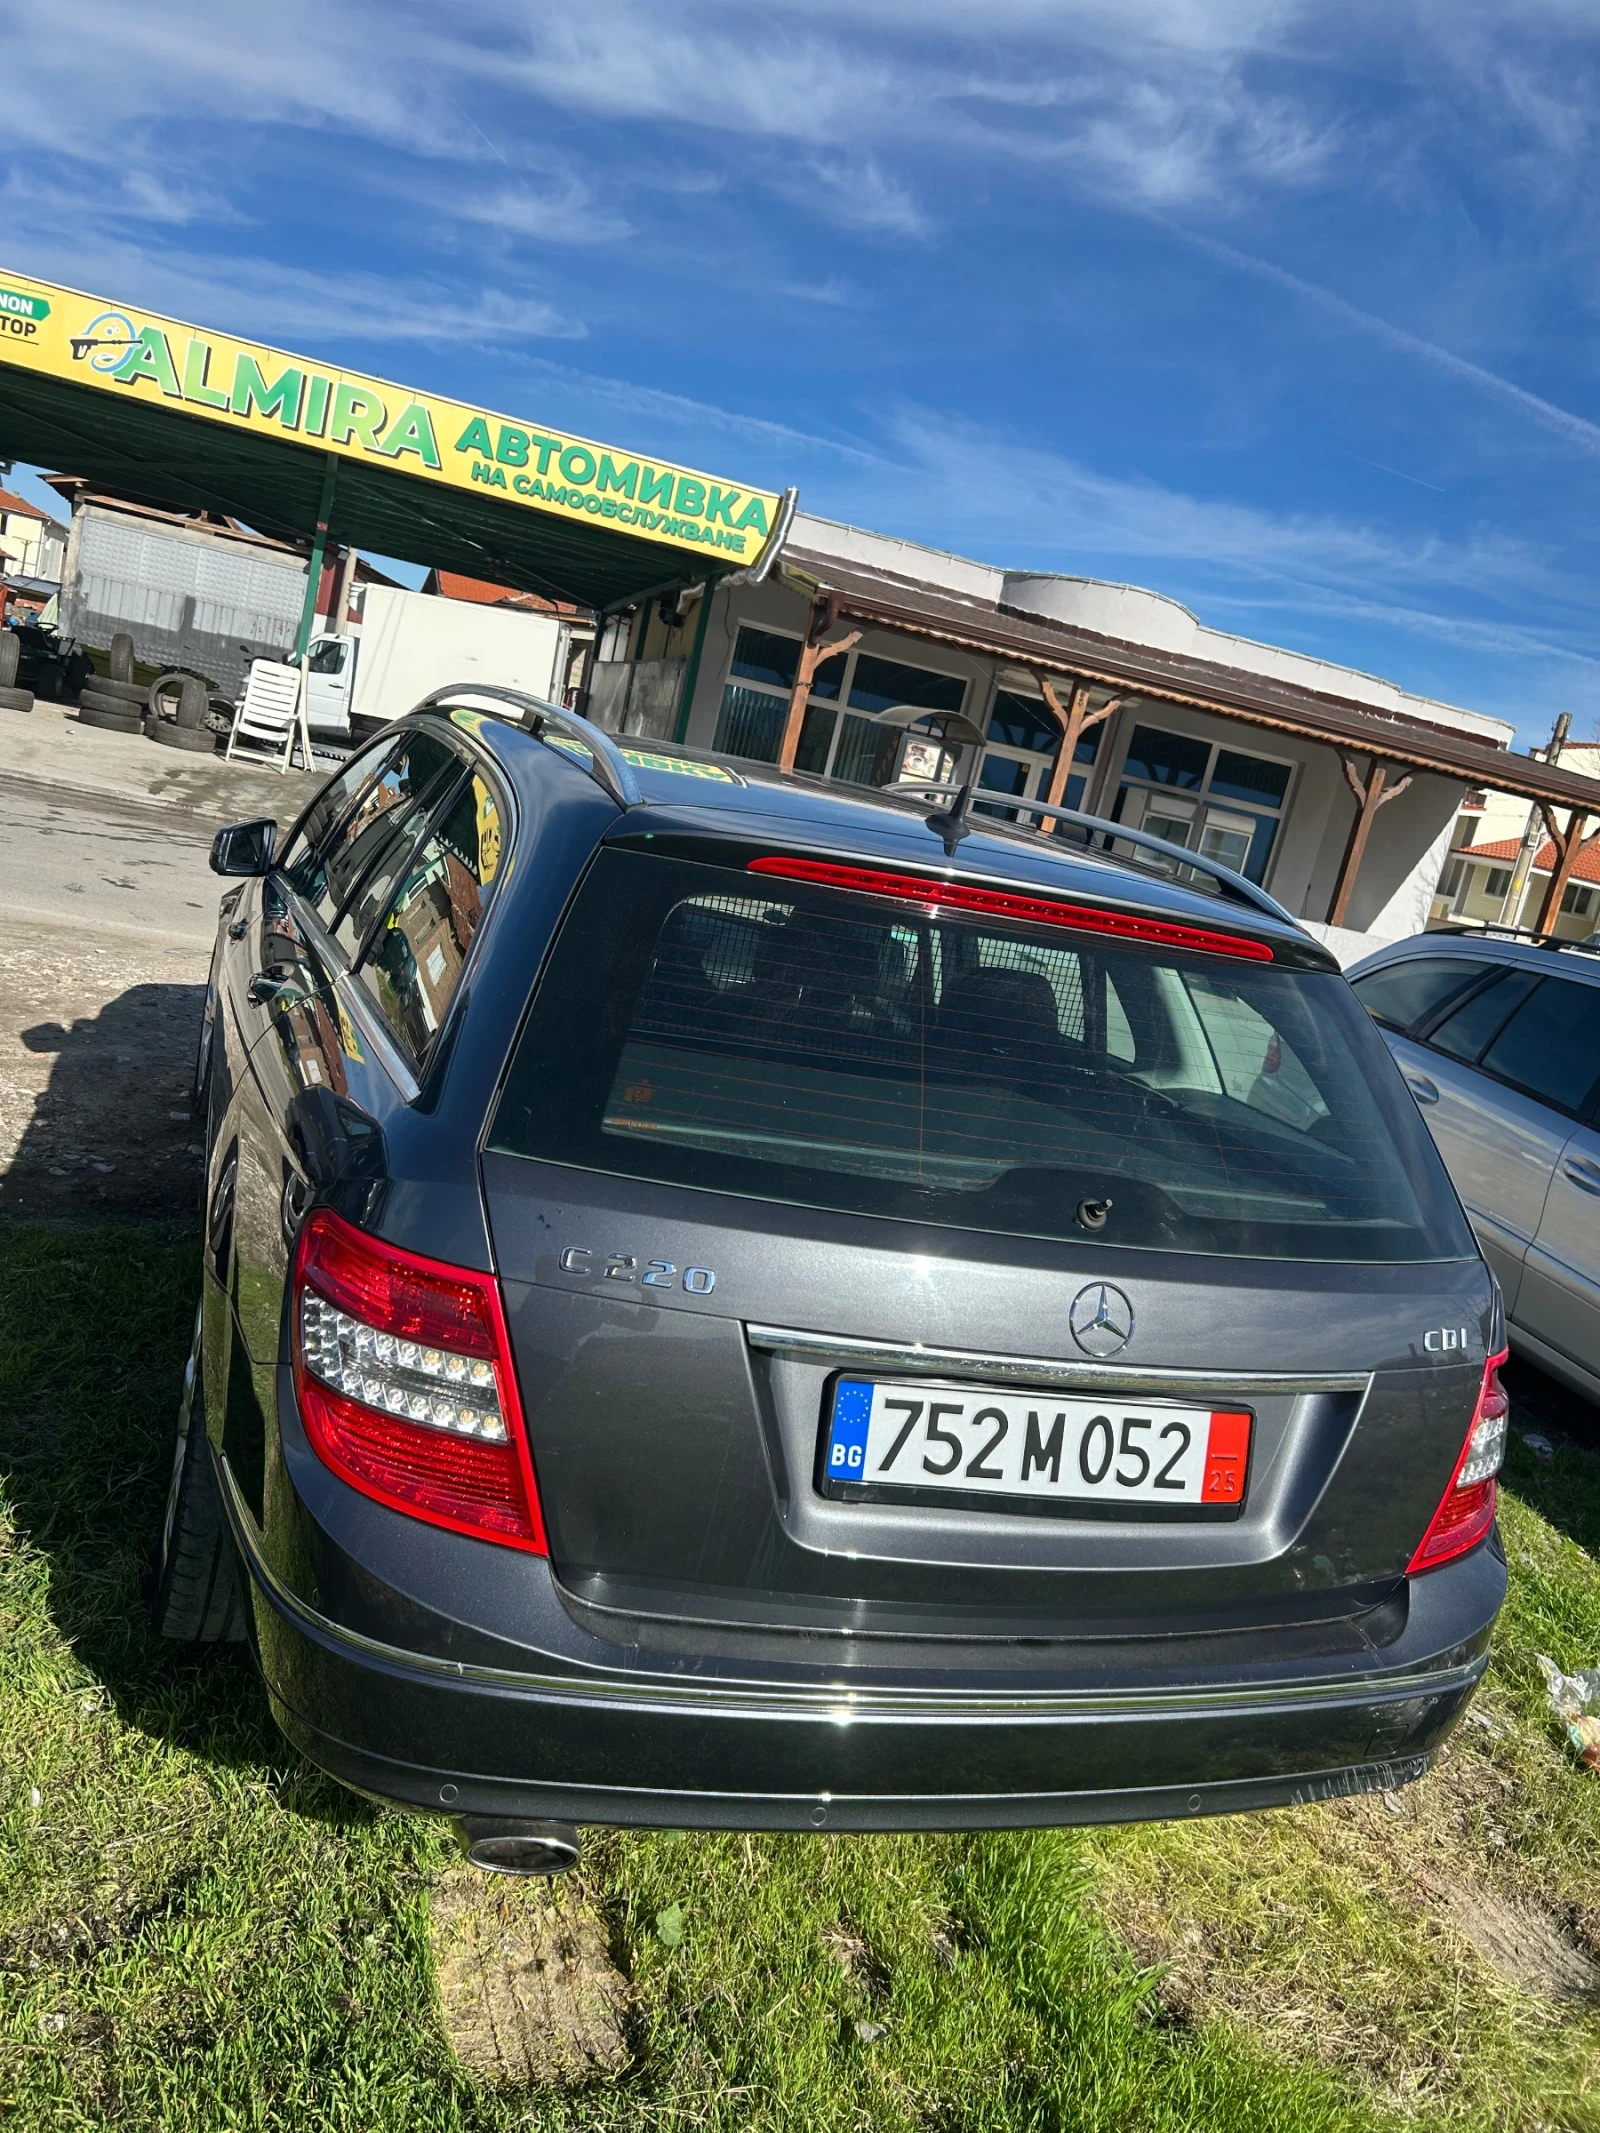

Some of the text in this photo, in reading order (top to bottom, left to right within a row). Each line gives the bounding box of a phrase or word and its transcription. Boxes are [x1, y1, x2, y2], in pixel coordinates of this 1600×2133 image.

[0, 291, 33, 316] NON
[113, 326, 441, 470] ALMIRA
[454, 417, 768, 537] АВТОМИВКА
[471, 462, 746, 553] НА САМООБСЛУЖВАНЕ
[558, 1244, 716, 1295] C 220
[1422, 1327, 1468, 1352] CDI
[831, 1443, 862, 1468] BG
[878, 1398, 1191, 1490] 752 M 052
[1208, 1469, 1236, 1493] 25
